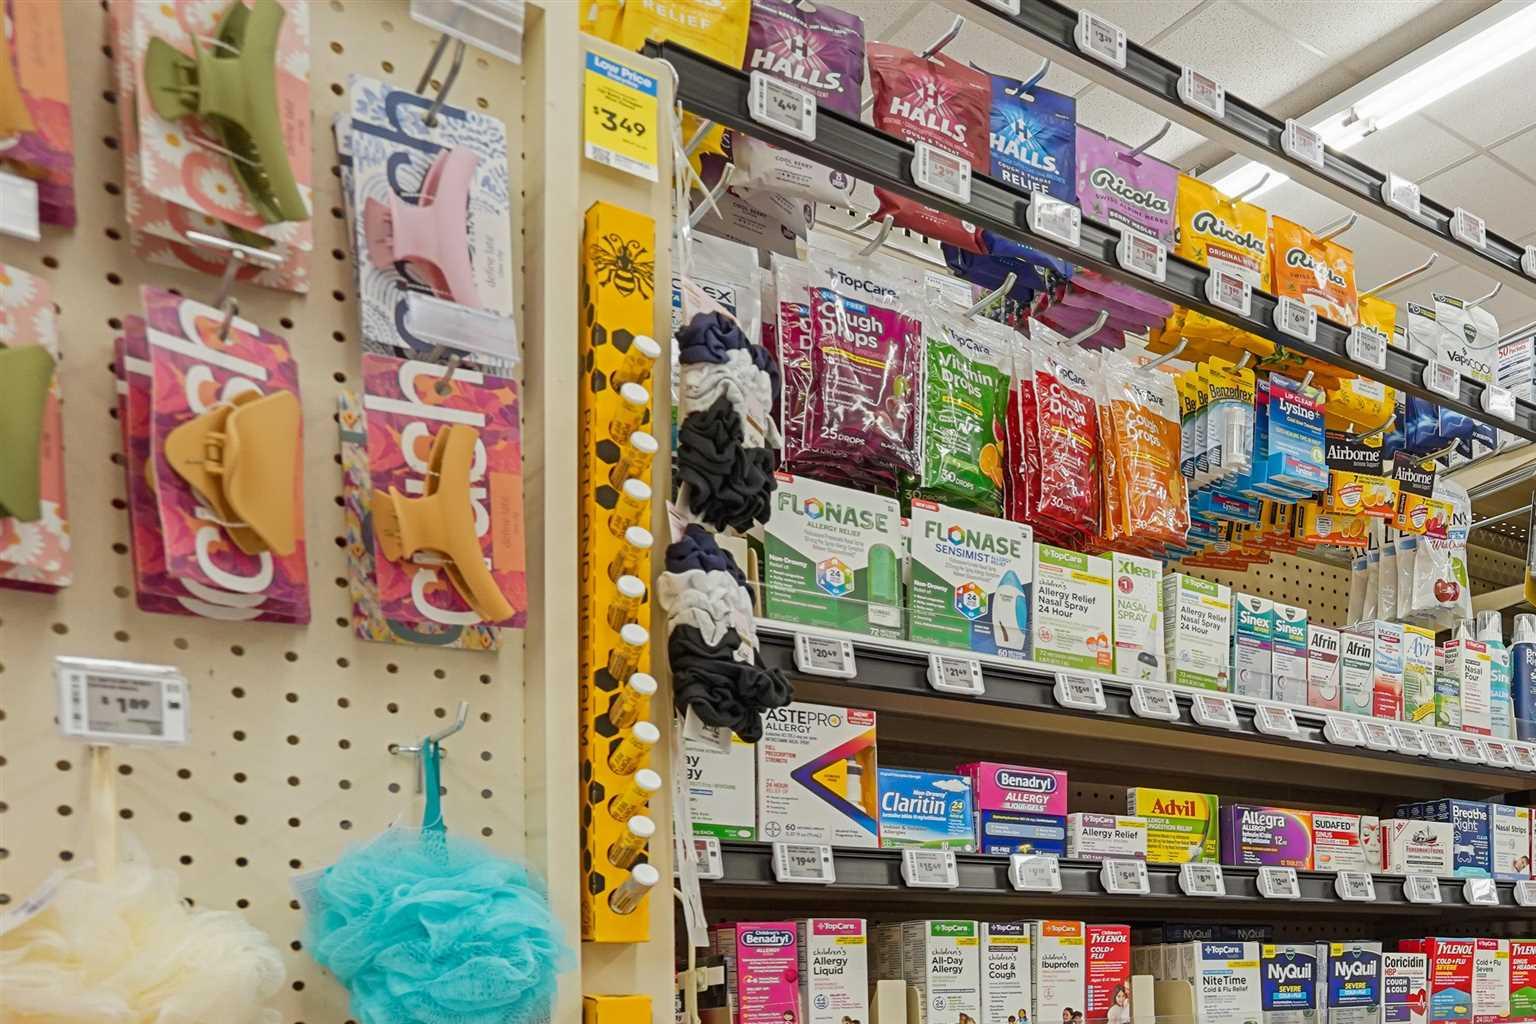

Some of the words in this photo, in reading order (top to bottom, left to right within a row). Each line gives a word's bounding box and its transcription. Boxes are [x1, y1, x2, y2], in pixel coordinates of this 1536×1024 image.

[593, 56, 620, 73] Low
[621, 67, 652, 86] Price
[1090, 169, 1169, 214] Ricola
[1193, 212, 1265, 255] Ricola
[838, 272, 896, 297] TopCare
[1209, 384, 1253, 400] Benzedrex
[1328, 445, 1379, 462] Airborne
[1396, 469, 1433, 484] Airborne
[777, 491, 889, 533] FLONASE
[924, 520, 1022, 558] FLONASE
[935, 543, 990, 562] SENSIMIST
[1038, 586, 1068, 603] Allergy
[1071, 592, 1096, 605] Relief
[1038, 596, 1061, 611] Nasal
[1063, 602, 1089, 615] Spray
[1038, 607, 1049, 616] 24
[1052, 608, 1073, 619] Hour
[1118, 600, 1148, 614] NASAL
[1118, 610, 1148, 623] SPRAY
[1240, 611, 1271, 629] Sinex
[1275, 619, 1304, 636] Sinex
[1312, 632, 1337, 650] Afrin
[1346, 640, 1372, 659] Afrin
[765, 721, 812, 734] ALLERGY
[1000, 773, 1051, 790] Benadryl
[882, 791, 945, 816] Claritin
[1005, 792, 1049, 803] ALLERGY
[1152, 798, 1195, 817] Advil
[1453, 805, 1487, 821] Breathe
[1242, 810, 1285, 829] Allegra
[1316, 819, 1351, 830] SUDAFED
[1453, 818, 1478, 833] Right
[1082, 828, 1113, 840] Allergy
[1115, 830, 1138, 839] Relief
[1495, 823, 1512, 833] Nasal
[1513, 825, 1527, 835] Strips
[746, 934, 790, 945] Benadryl
[1091, 934, 1127, 944] TYLENOL
[1436, 941, 1473, 956] TYLENOL
[813, 956, 848, 968] Allergy
[932, 956, 963, 968] All-Day
[932, 964, 963, 975] Allergy
[989, 963, 1008, 971] Cold
[1041, 960, 1079, 970] Ibuprofen
[1384, 956, 1424, 968] Coricidin
[813, 966, 843, 976] Liquid
[989, 971, 1016, 980] Cough
[1268, 962, 1312, 981] NyQuil
[1334, 960, 1377, 981] NyQuil
[1279, 985, 1302, 993] SEVERE
[1386, 978, 1408, 986] COUGH
